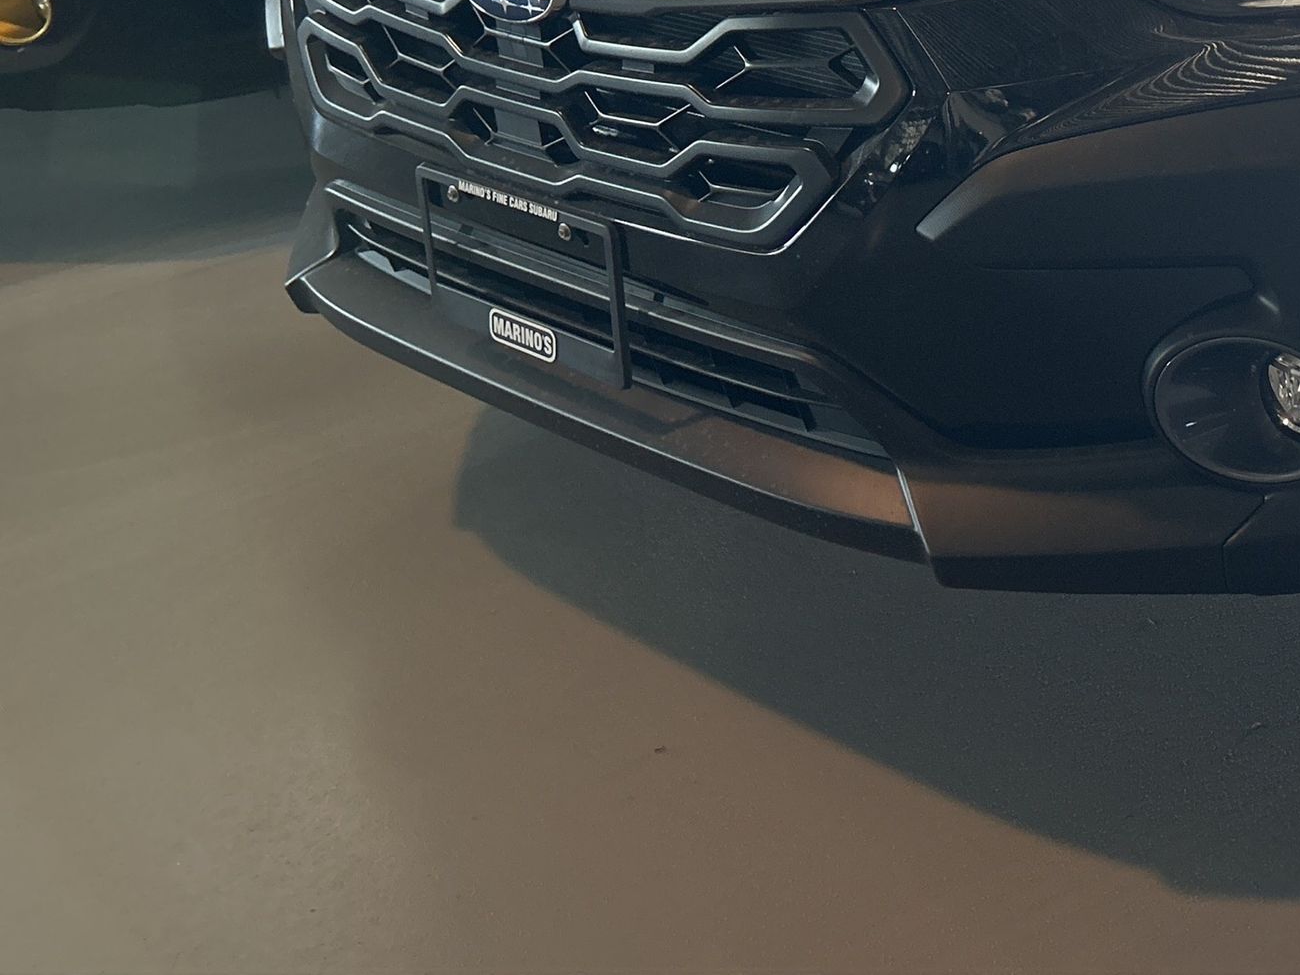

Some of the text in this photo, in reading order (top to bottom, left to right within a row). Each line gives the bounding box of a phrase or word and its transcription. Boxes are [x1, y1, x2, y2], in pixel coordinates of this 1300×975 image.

[458, 180, 558, 222] MARINO'S FINE CARS SUBARU
[493, 315, 552, 355] MARINO'S
